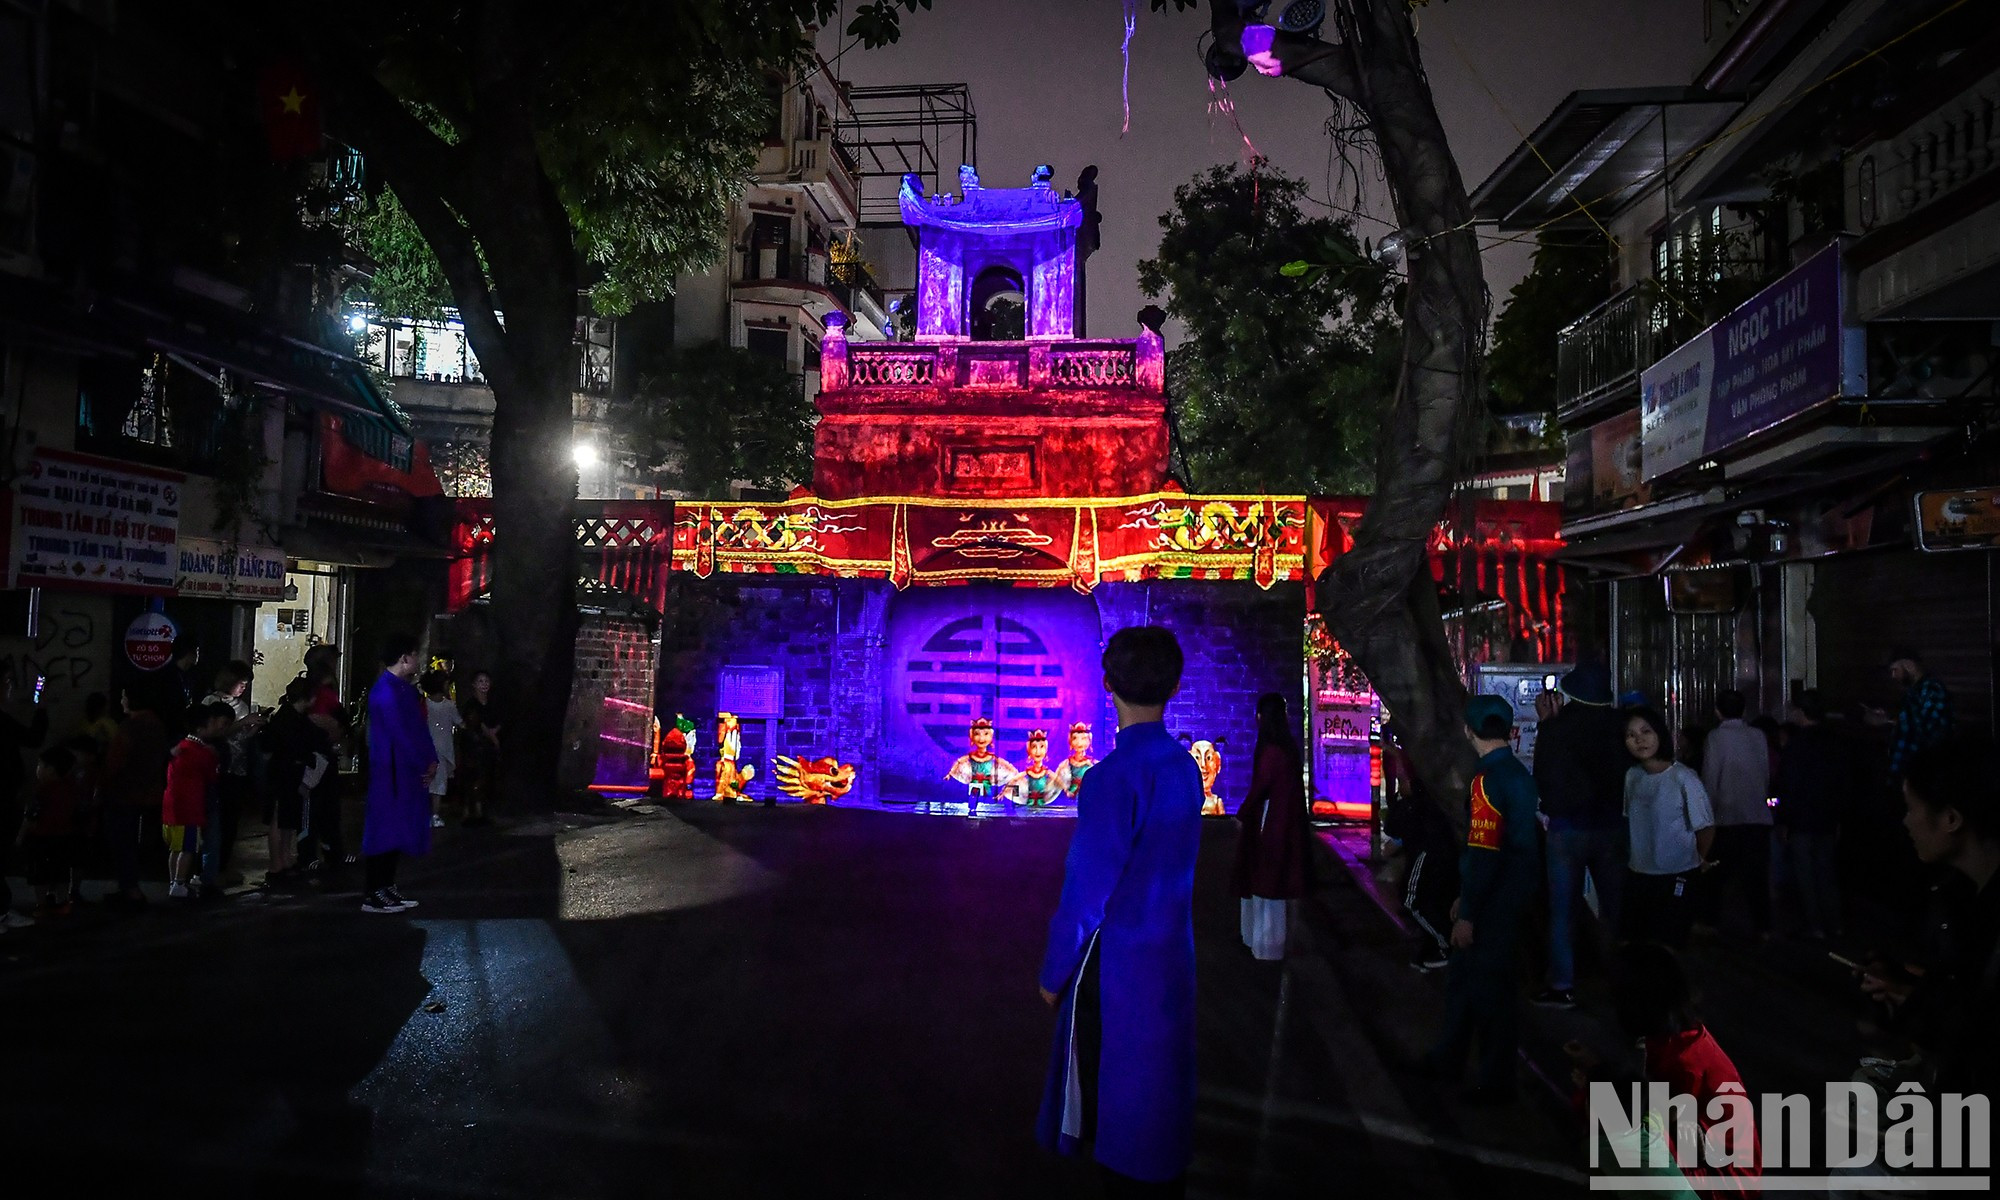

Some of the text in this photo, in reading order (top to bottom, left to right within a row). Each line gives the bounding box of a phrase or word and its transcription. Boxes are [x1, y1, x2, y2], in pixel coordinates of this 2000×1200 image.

[1729, 278, 1808, 359] NGỌC THU
[20, 506, 63, 529] TRUNG
[66, 511, 93, 534] TÂM
[114, 516, 129, 538] SỐ
[29, 535, 70, 555] TRUNG
[73, 539, 99, 558] TÂM
[180, 547, 215, 574] HOÀNG
[1324, 715, 1352, 730] ĐÊM
